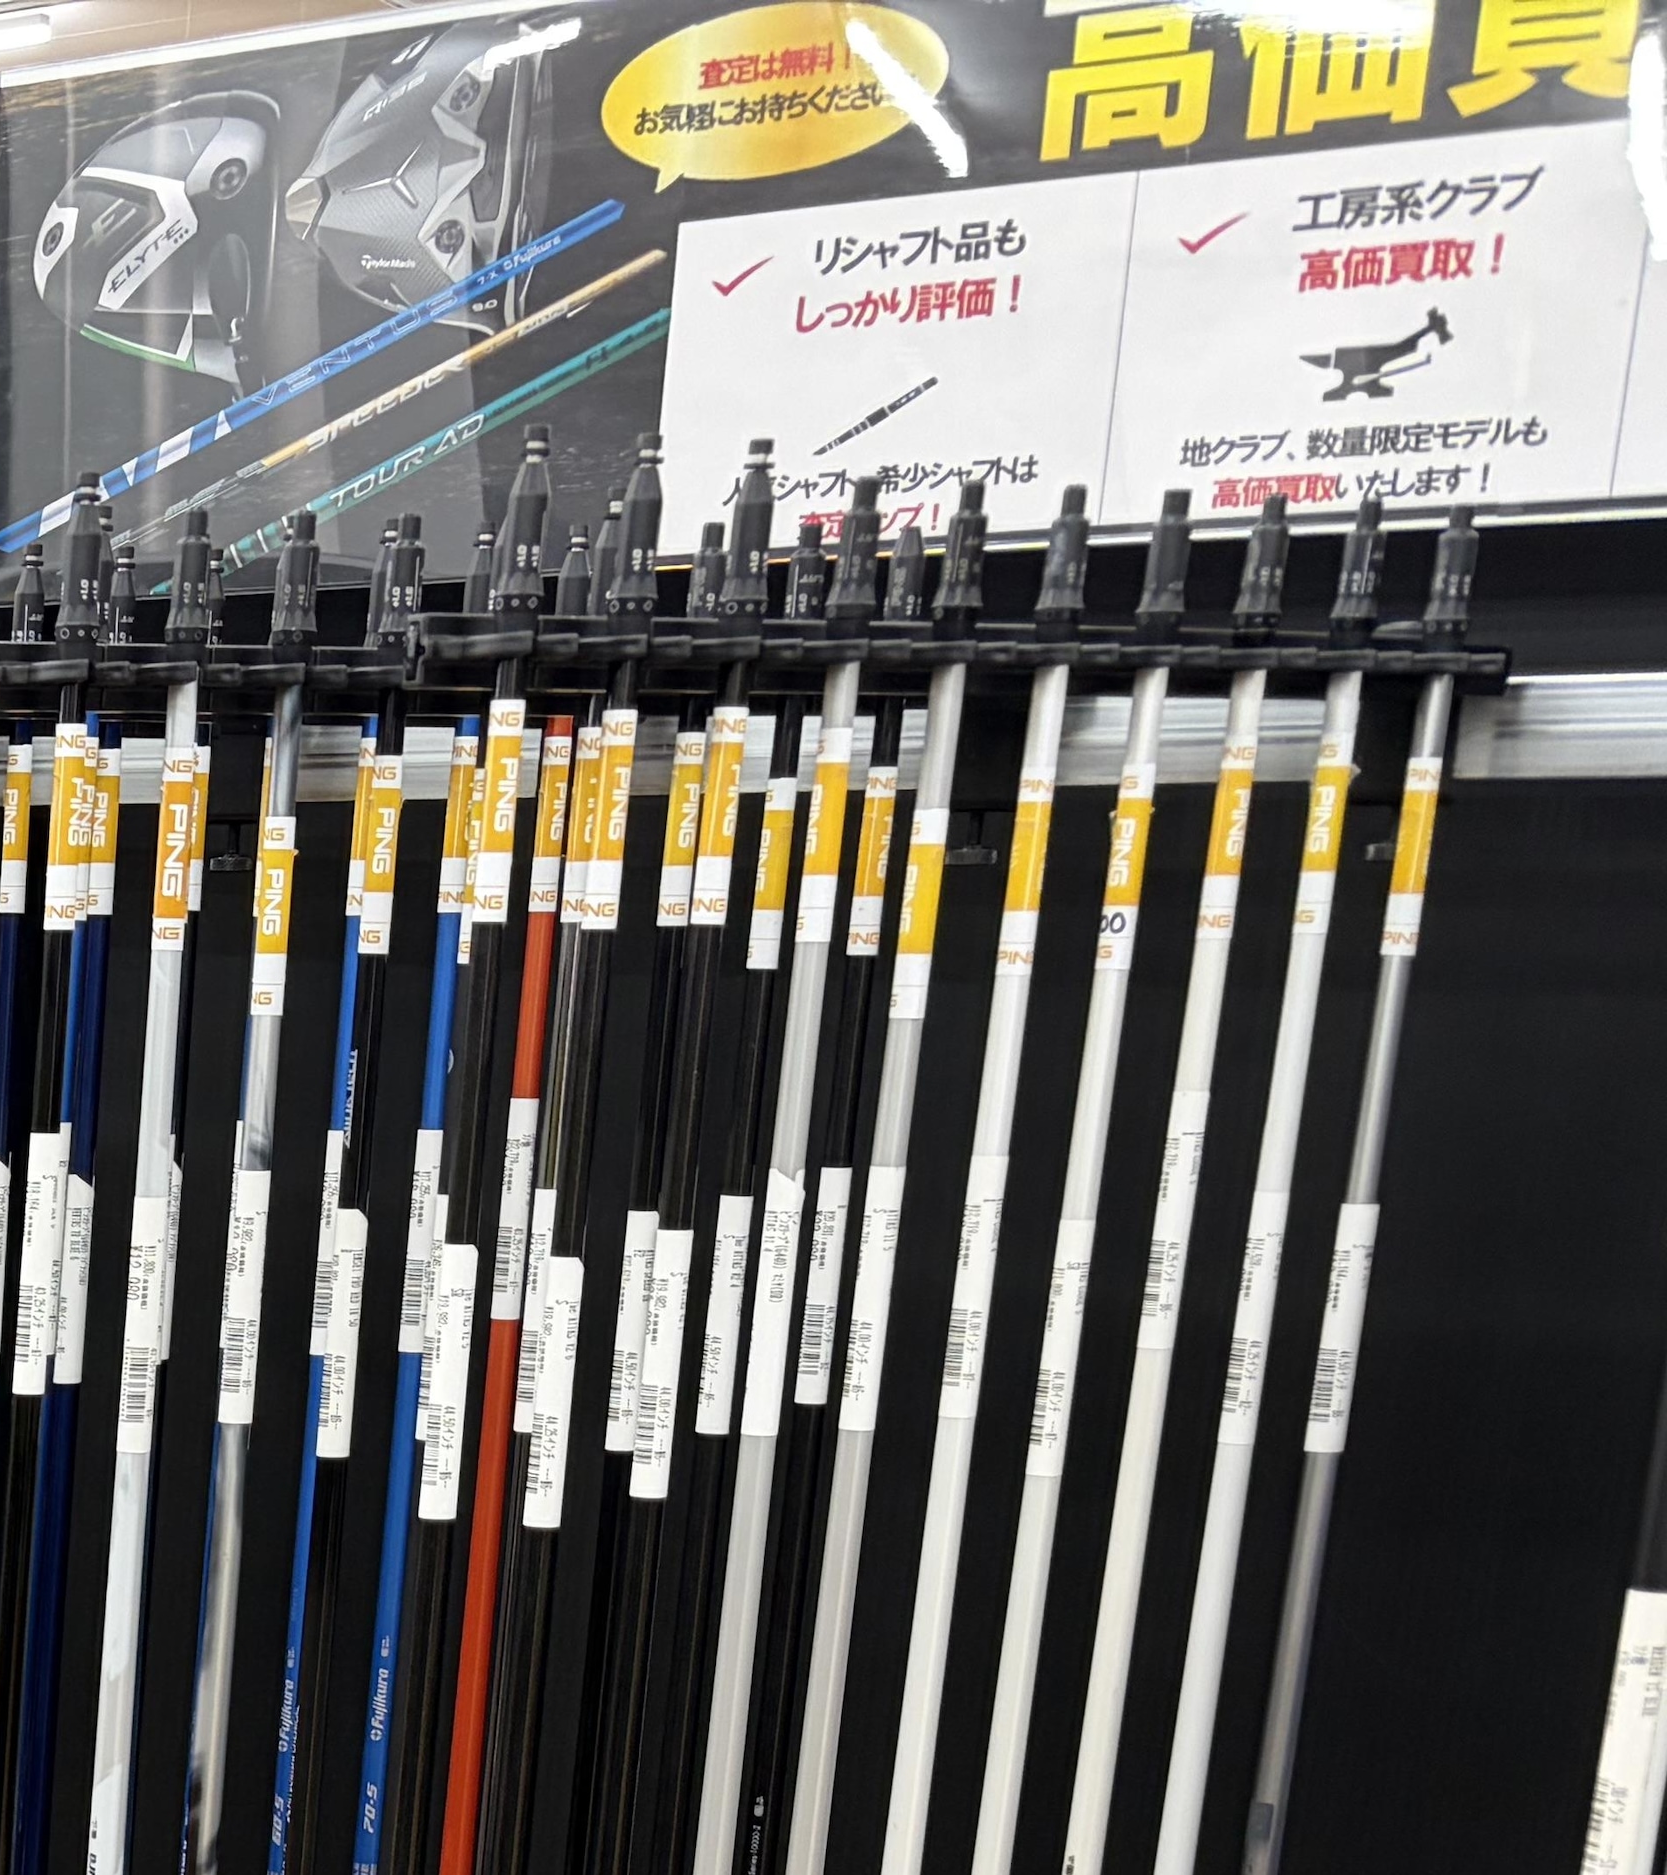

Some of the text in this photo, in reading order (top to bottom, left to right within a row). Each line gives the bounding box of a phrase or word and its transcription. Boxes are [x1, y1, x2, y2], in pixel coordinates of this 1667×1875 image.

[634, 78, 886, 136] お気軽にお持ちください
[1291, 167, 1545, 236] 工房系クラブ
[107, 218, 183, 294] ELYTE
[812, 217, 1028, 276] リシャフト品も
[1298, 234, 1506, 294] 高価買取！
[795, 274, 1023, 335] しっかり評価！
[250, 293, 459, 408] VENTUS
[327, 412, 486, 508] TOUR AD
[1180, 415, 1549, 469] 地クラブ、数量限定モデルも
[1212, 464, 1494, 510] 高価買取いたします！
[92, 791, 108, 848] PING
[494, 757, 517, 833] PING
[550, 782, 566, 841] PING
[608, 766, 631, 842] PING
[679, 783, 699, 849] PING
[1226, 786, 1249, 860] PING
[1307, 784, 1335, 854] PING
[162, 803, 188, 897] PING
[372, 807, 395, 875] PING
[1106, 817, 1134, 887] PING
[262, 868, 284, 937] PING
[280, 1679, 295, 1738] Fujikura
[371, 1668, 389, 1728] Fujikura
